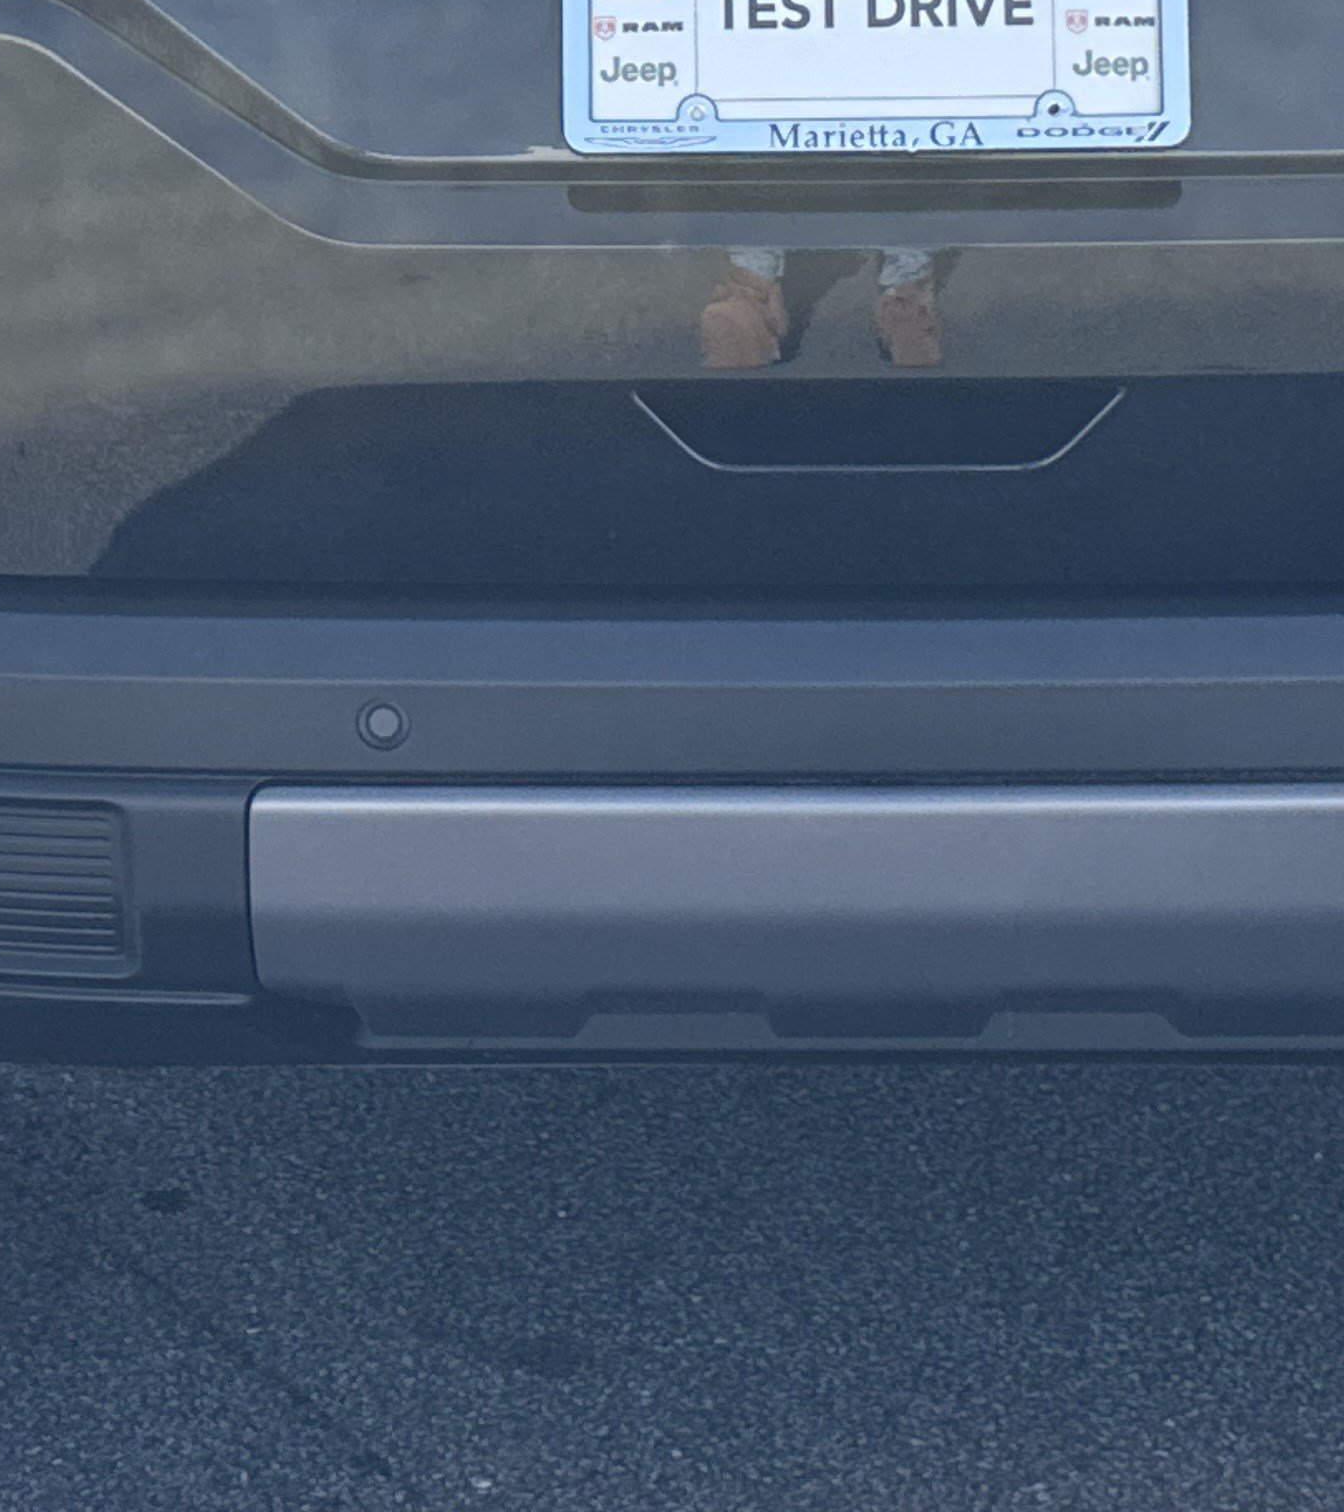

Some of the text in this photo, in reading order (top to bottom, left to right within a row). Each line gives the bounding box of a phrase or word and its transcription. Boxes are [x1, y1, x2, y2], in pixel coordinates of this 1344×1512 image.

[621, 20, 685, 33] RAM
[1093, 15, 1156, 28] RAM
[599, 55, 678, 87] Jeep
[1071, 49, 1150, 81] Jeep
[599, 124, 701, 134] CHRYSLER
[768, 119, 984, 149] Marietta, GA
